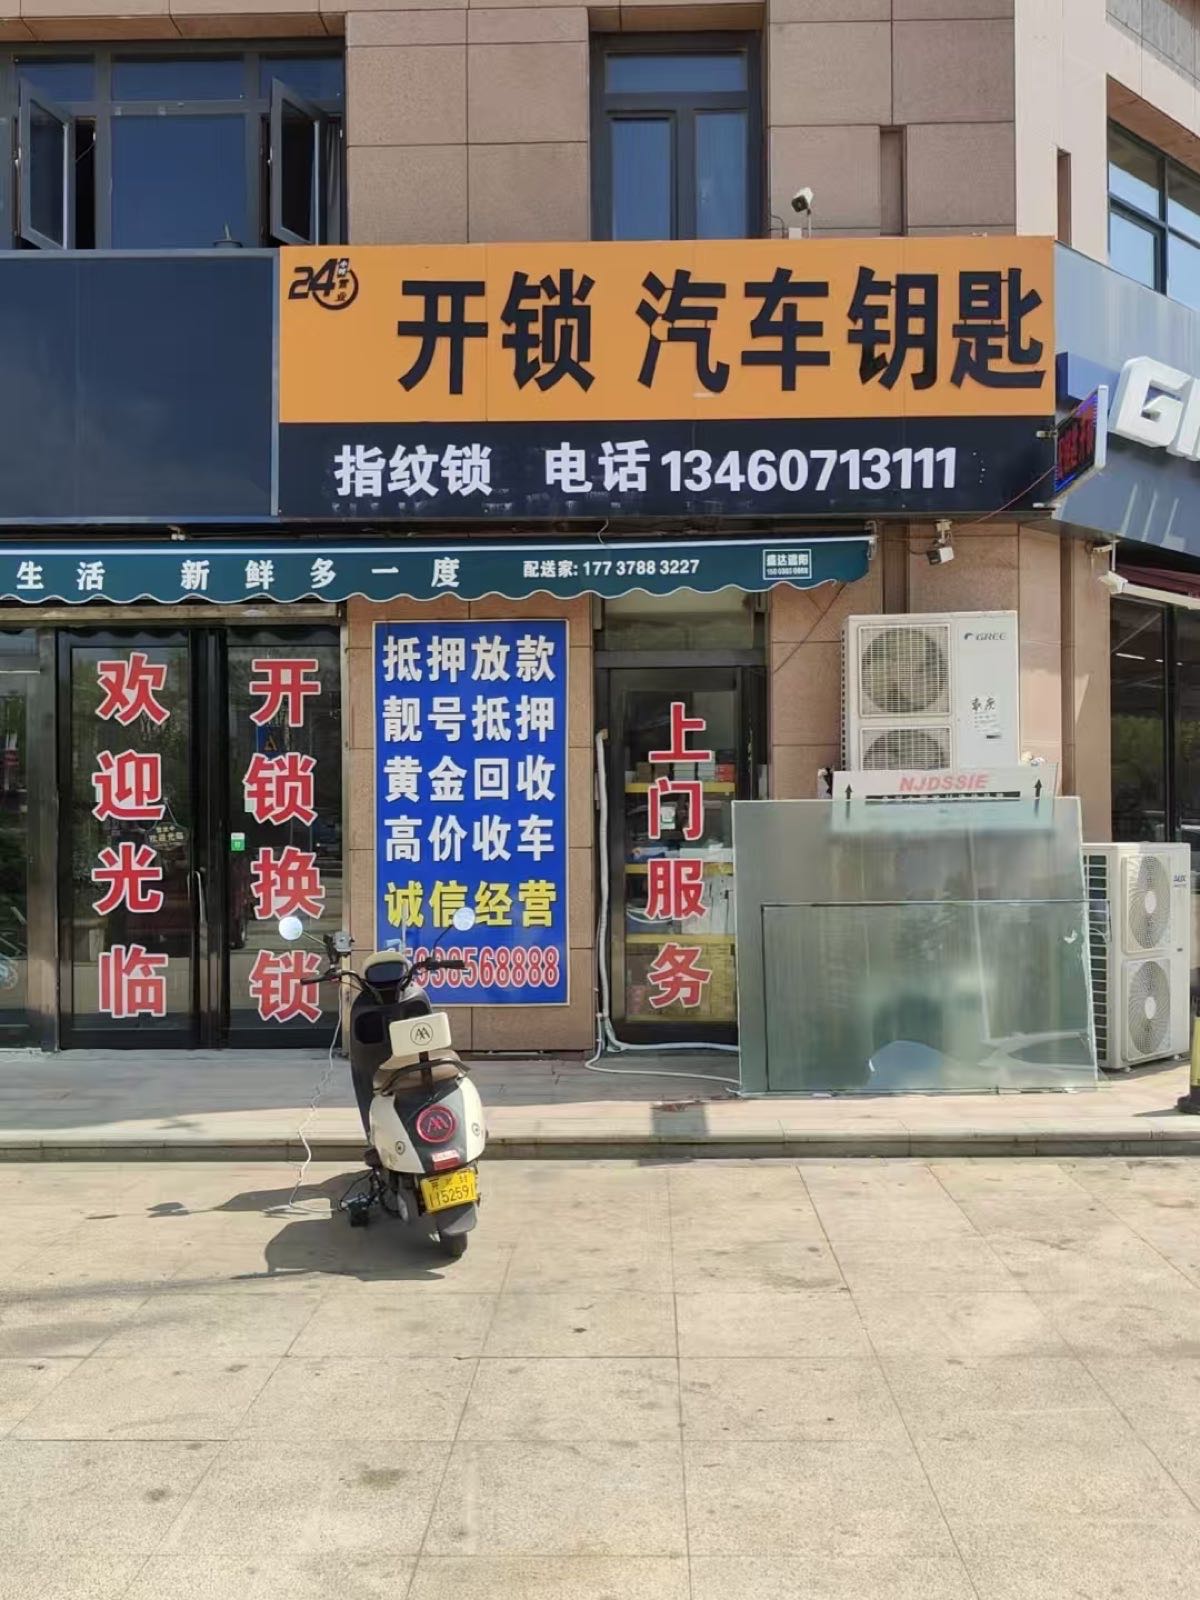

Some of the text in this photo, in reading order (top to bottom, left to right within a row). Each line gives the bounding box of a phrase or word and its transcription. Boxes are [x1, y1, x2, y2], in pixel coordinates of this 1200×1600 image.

[397, 265, 1047, 394] 开锁 汽车钥匙
[334, 443, 493, 498] 指纹锁
[16, 557, 461, 590] 生活 新鲜多一度
[583, 560, 612, 576] 177
[616, 560, 656, 576] 3788
[659, 559, 700, 575] 3227
[382, 634, 556, 683] 抵押放款
[382, 694, 555, 742] 靓号抵押
[383, 754, 556, 803] 黄金回收
[92, 652, 170, 1020] 欢迎光临
[243, 658, 326, 1023] 开锁换锁
[384, 814, 555, 862] 高价收车
[645, 702, 712, 1009] 上门服务
[384, 879, 557, 928] 诚信经营
